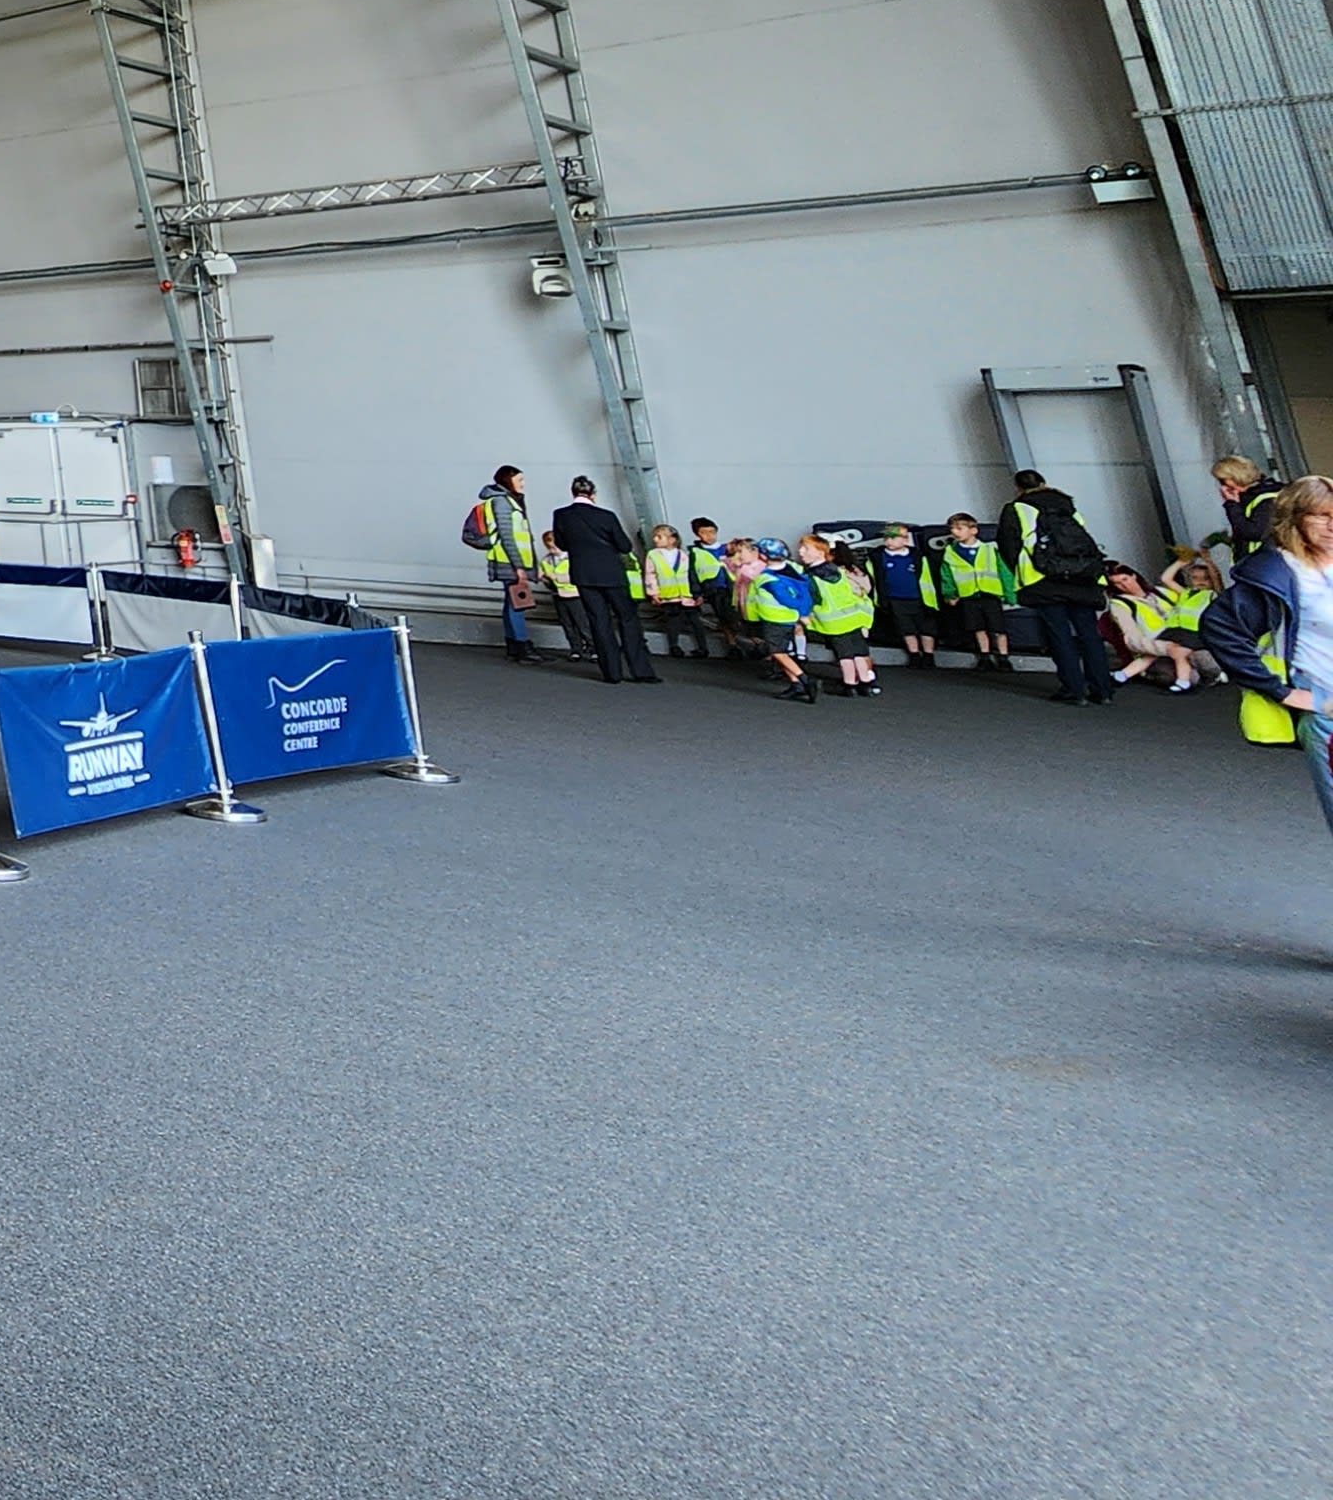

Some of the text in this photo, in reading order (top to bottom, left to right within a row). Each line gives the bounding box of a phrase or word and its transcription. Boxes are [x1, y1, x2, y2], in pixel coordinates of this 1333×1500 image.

[281, 697, 348, 720] CONCORDE
[283, 717, 341, 735] CONFERENCE
[283, 736, 319, 752] CENTRE
[68, 741, 144, 782] RUNWAY
